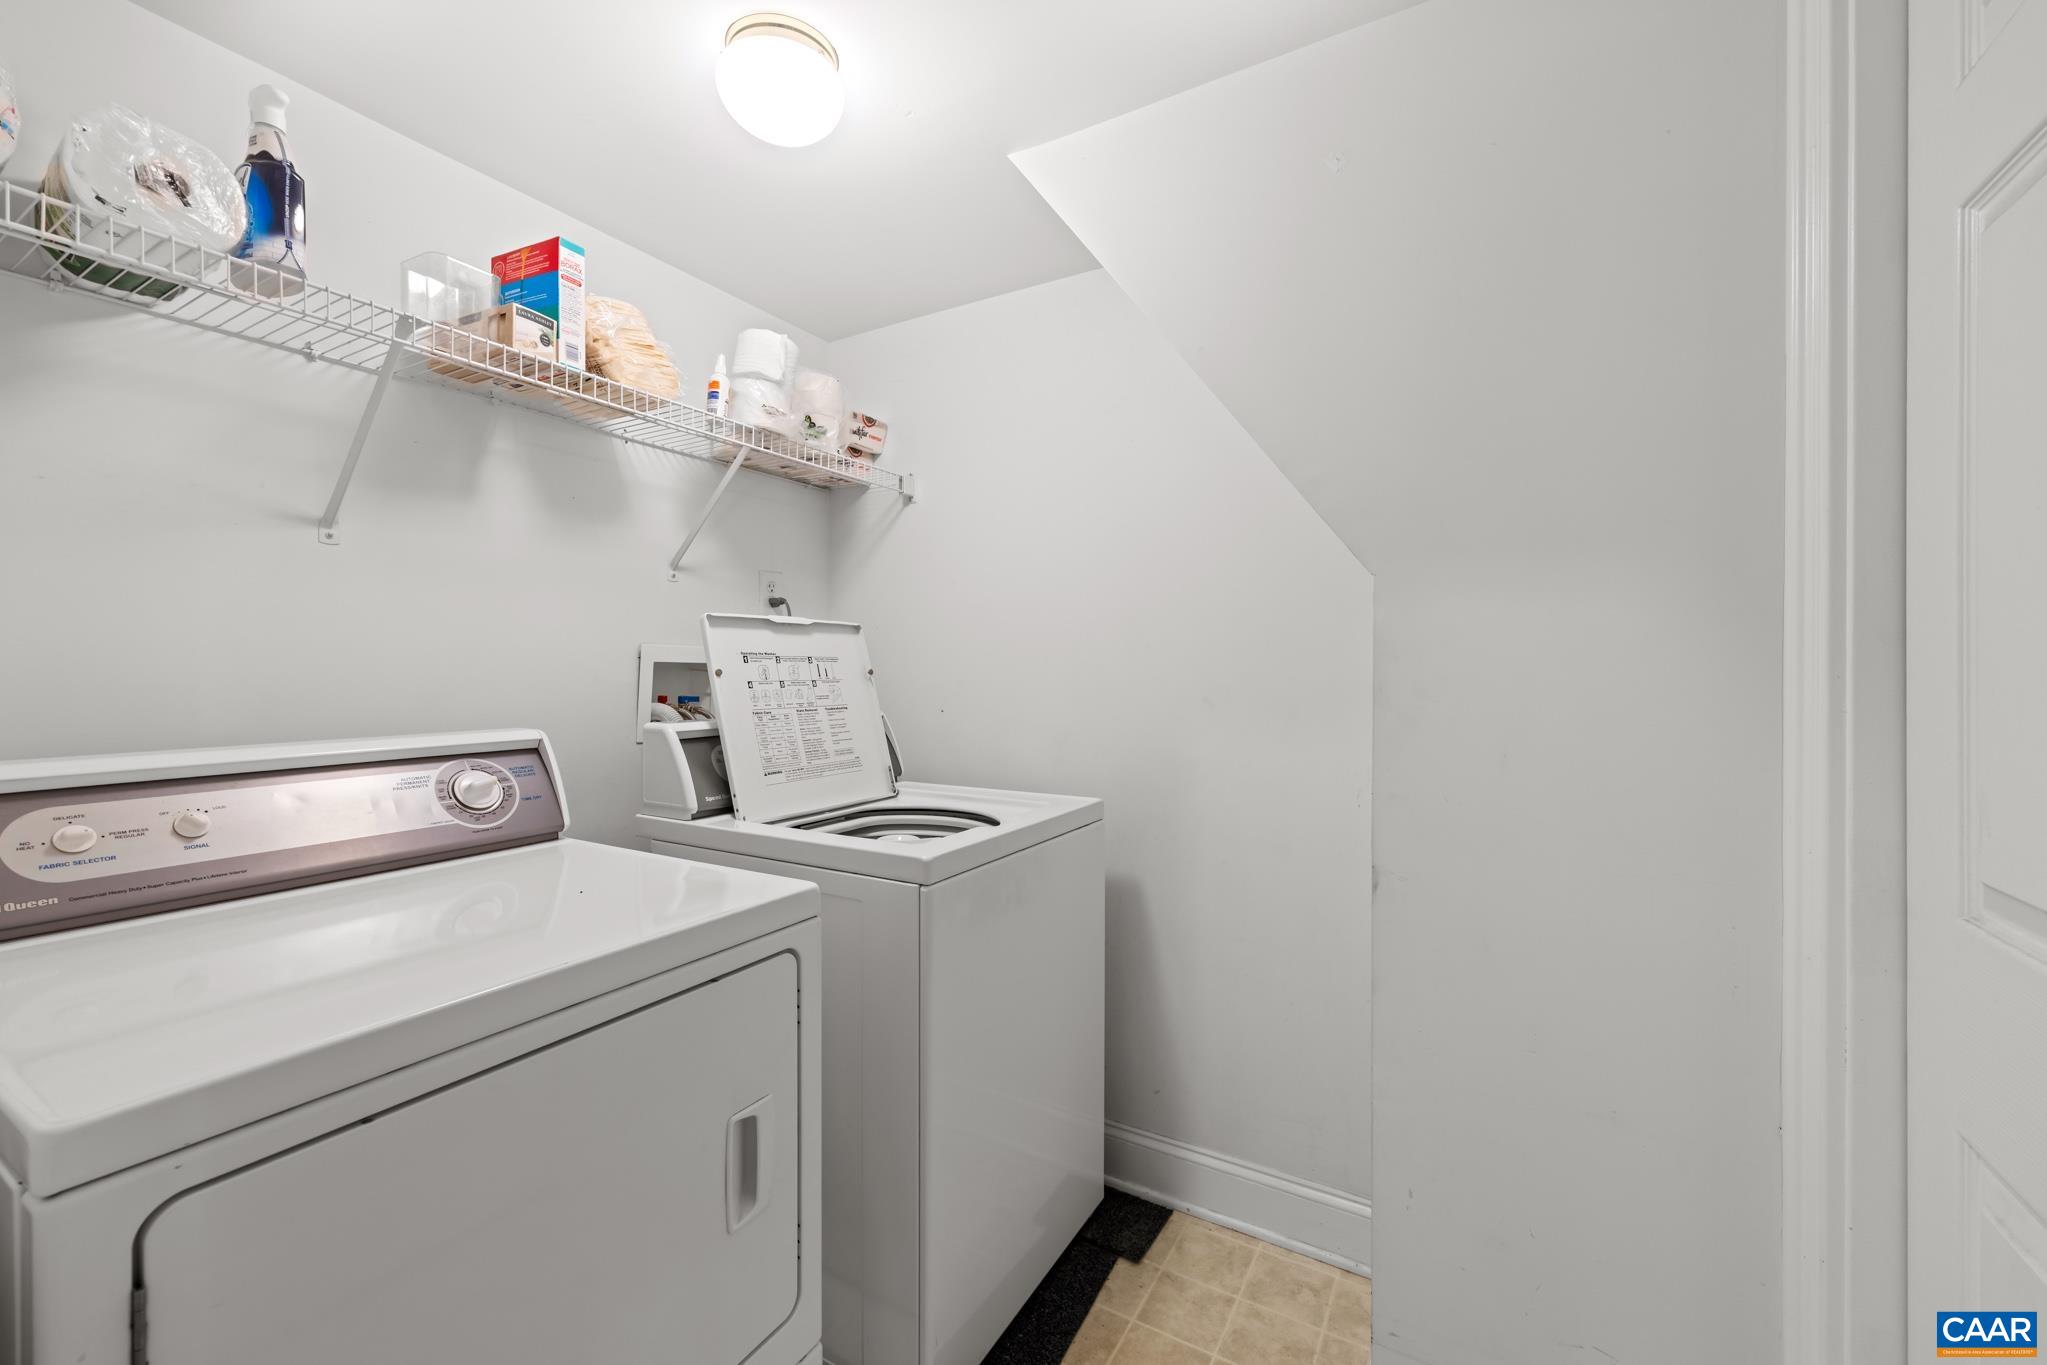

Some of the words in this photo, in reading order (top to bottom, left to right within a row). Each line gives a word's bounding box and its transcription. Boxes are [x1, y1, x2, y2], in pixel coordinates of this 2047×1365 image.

[38, 861, 71, 871] FABRIC
[72, 855, 117, 866] SELECTOR
[3, 897, 59, 912] Queen
